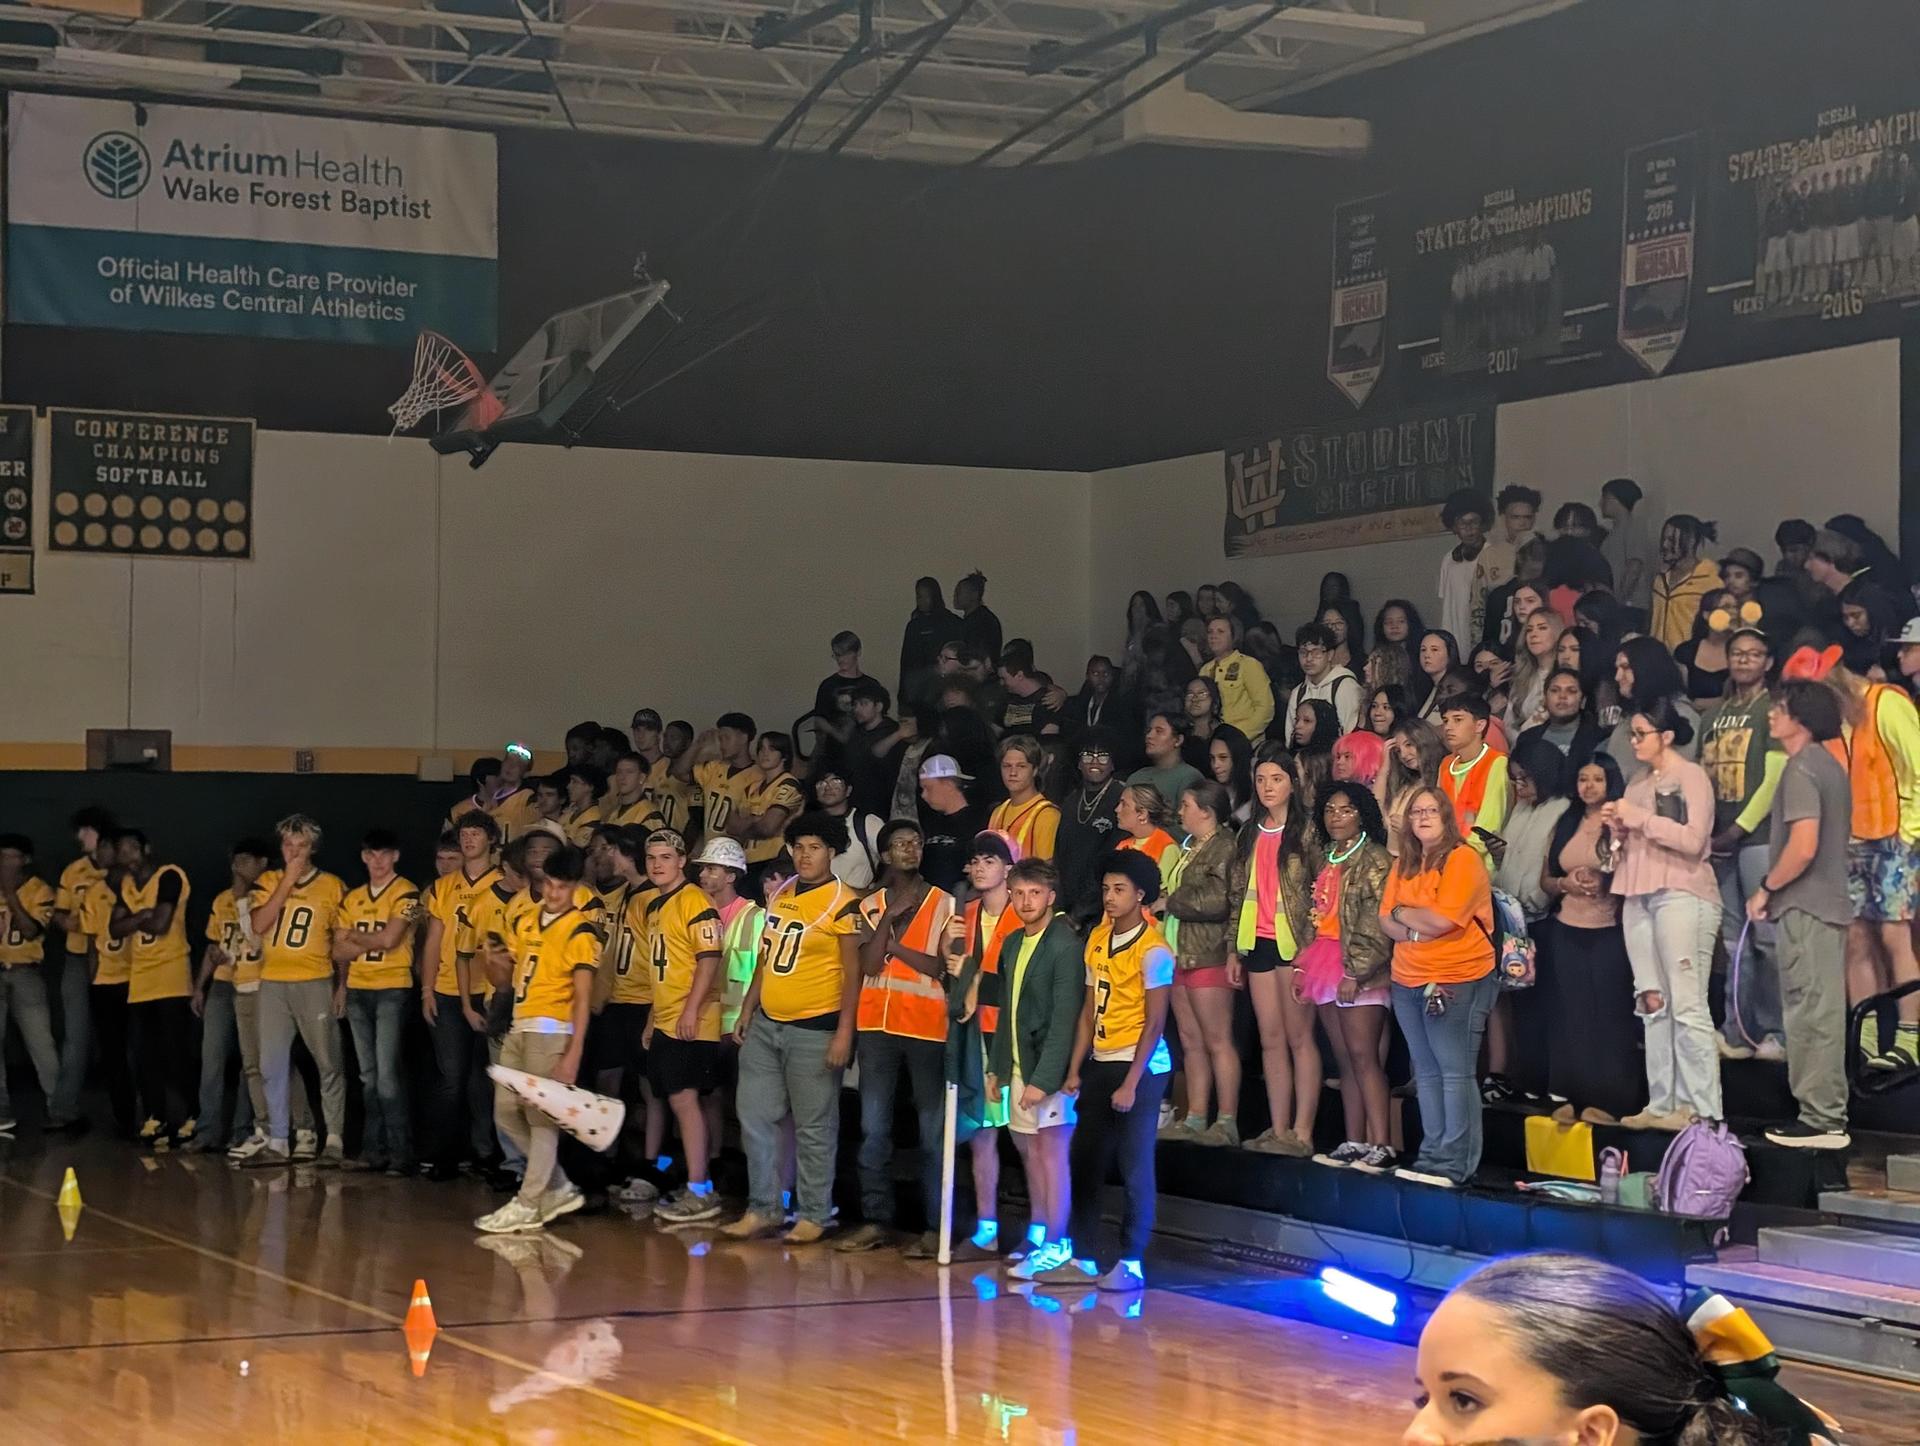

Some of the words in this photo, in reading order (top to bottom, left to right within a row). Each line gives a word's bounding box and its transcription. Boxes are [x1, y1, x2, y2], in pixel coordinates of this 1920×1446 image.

[163, 138, 287, 177] Atrium
[295, 148, 403, 188] Health
[1728, 143, 1792, 182] STATE
[1829, 109, 1920, 160] CHAMPI
[163, 175, 240, 204] Wake
[249, 182, 332, 211] Forest
[341, 190, 431, 220] Baptist
[1416, 219, 1468, 254] STATE
[97, 256, 179, 281] Official
[187, 262, 260, 287] Health
[267, 267, 320, 291] Care
[327, 272, 417, 298] Provider
[110, 283, 133, 304] of
[138, 284, 216, 309] Wilkes
[222, 290, 304, 315] Central
[311, 295, 405, 321] Athletics
[1821, 288, 1863, 319] 2016
[1487, 347, 1520, 375] 2017
[75, 419, 229, 445] CONFERENCE
[93, 443, 220, 465] CHAMPIONS
[96, 465, 207, 488] SOFTBALL
[706, 791, 732, 832] 70
[272, 906, 313, 948] 18
